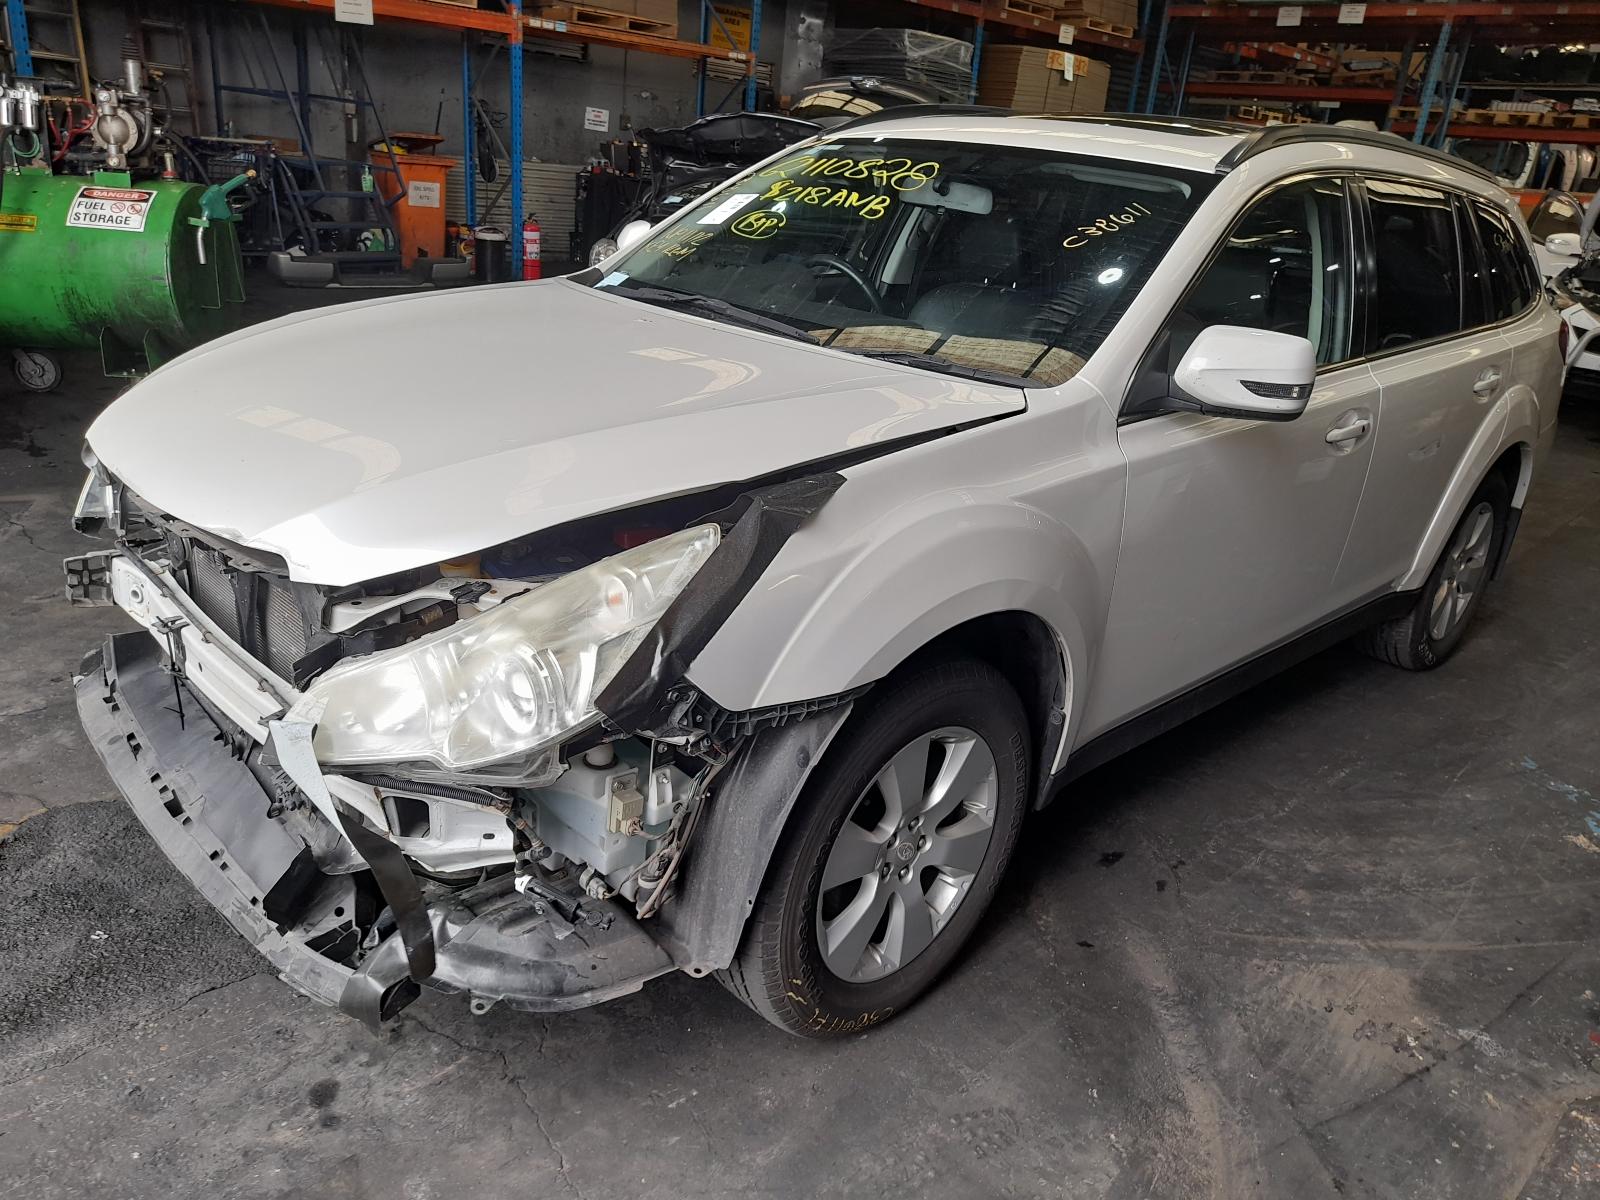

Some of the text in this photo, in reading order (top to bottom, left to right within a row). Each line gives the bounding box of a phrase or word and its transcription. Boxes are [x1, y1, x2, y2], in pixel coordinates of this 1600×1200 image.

[93, 190, 140, 199] DANGER
[77, 200, 106, 211] FUEL
[73, 212, 132, 226] STORAGE
[1062, 202, 1152, 248] C38611
